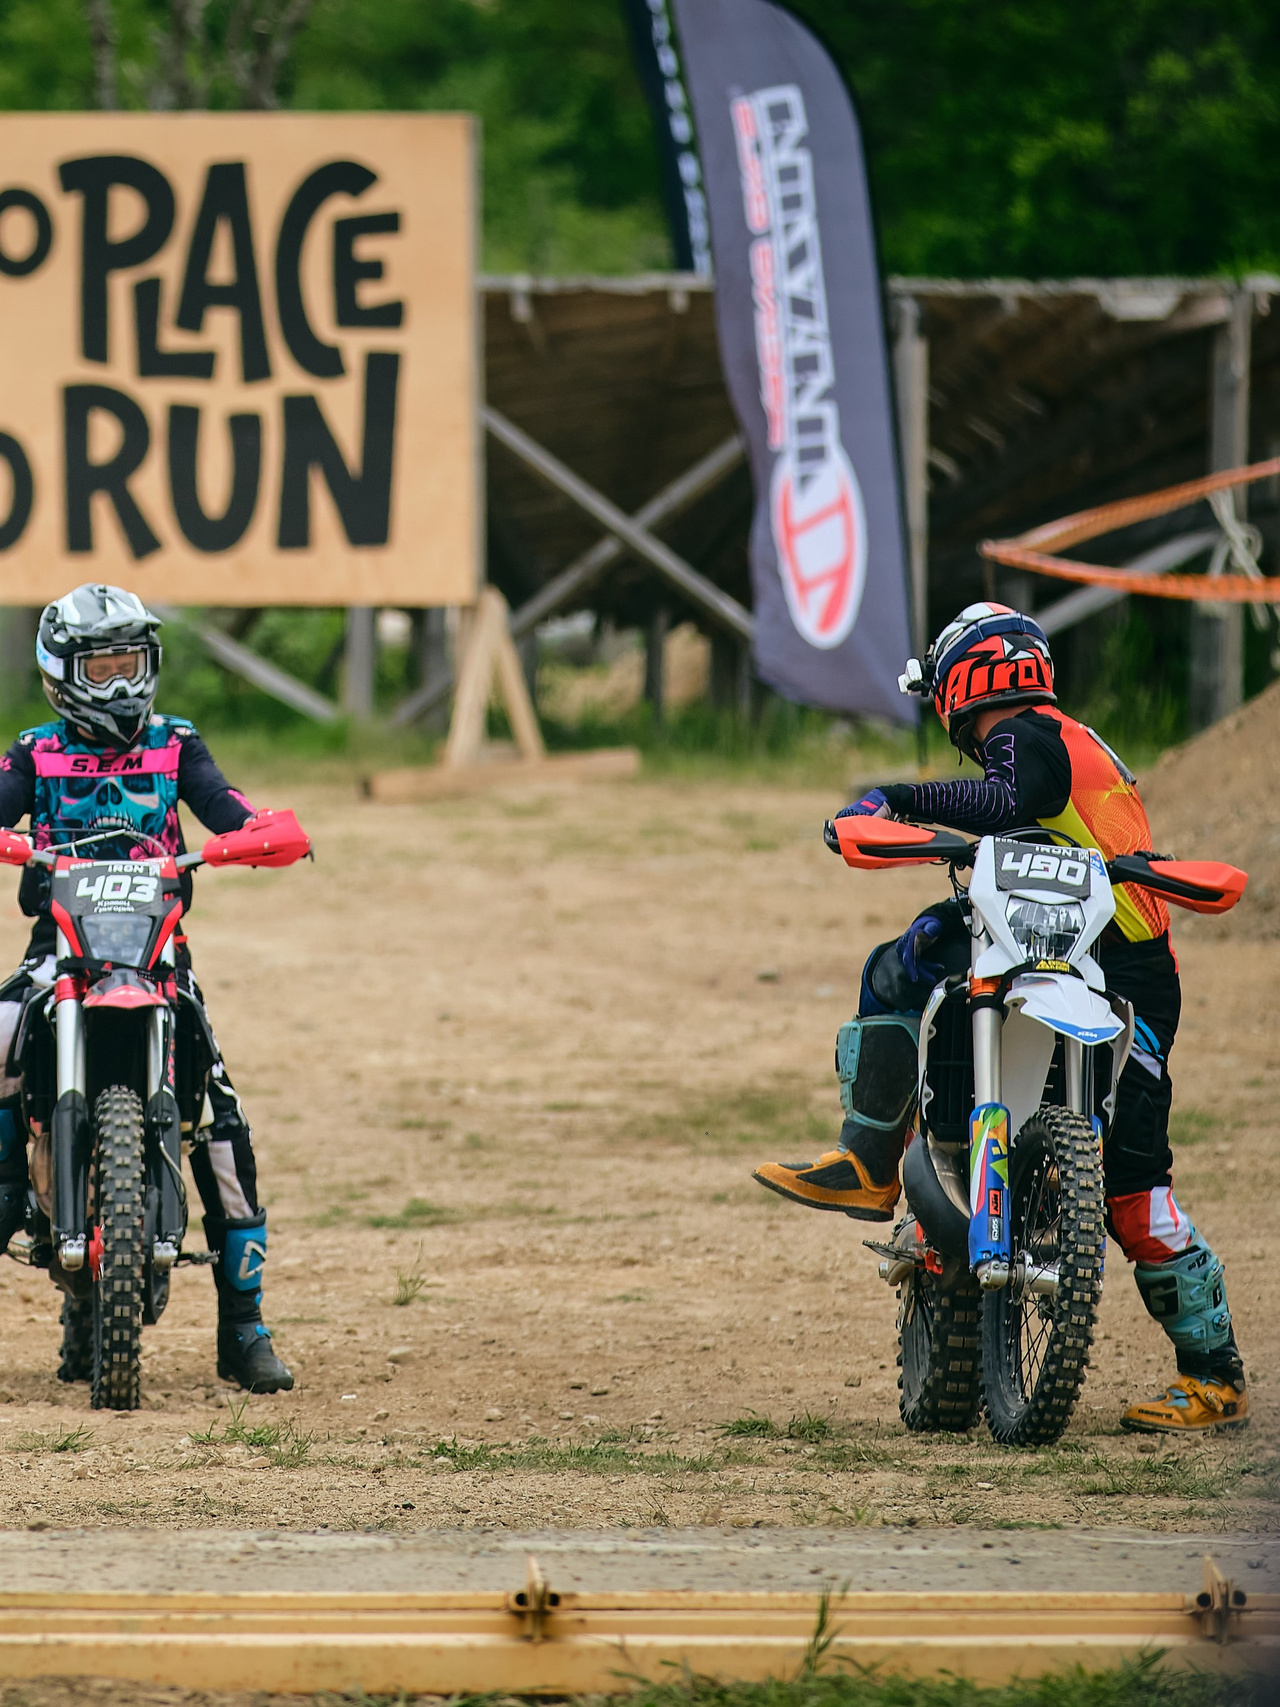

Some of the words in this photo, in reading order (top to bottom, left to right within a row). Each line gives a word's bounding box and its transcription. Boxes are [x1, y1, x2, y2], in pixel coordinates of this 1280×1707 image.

[56, 154, 405, 384] PLACE
[62, 351, 402, 561] RUN
[1035, 845, 1074, 857] IRON
[107, 864, 145, 874] IRON
[1001, 851, 1087, 887] 490
[75, 874, 159, 903] 403
